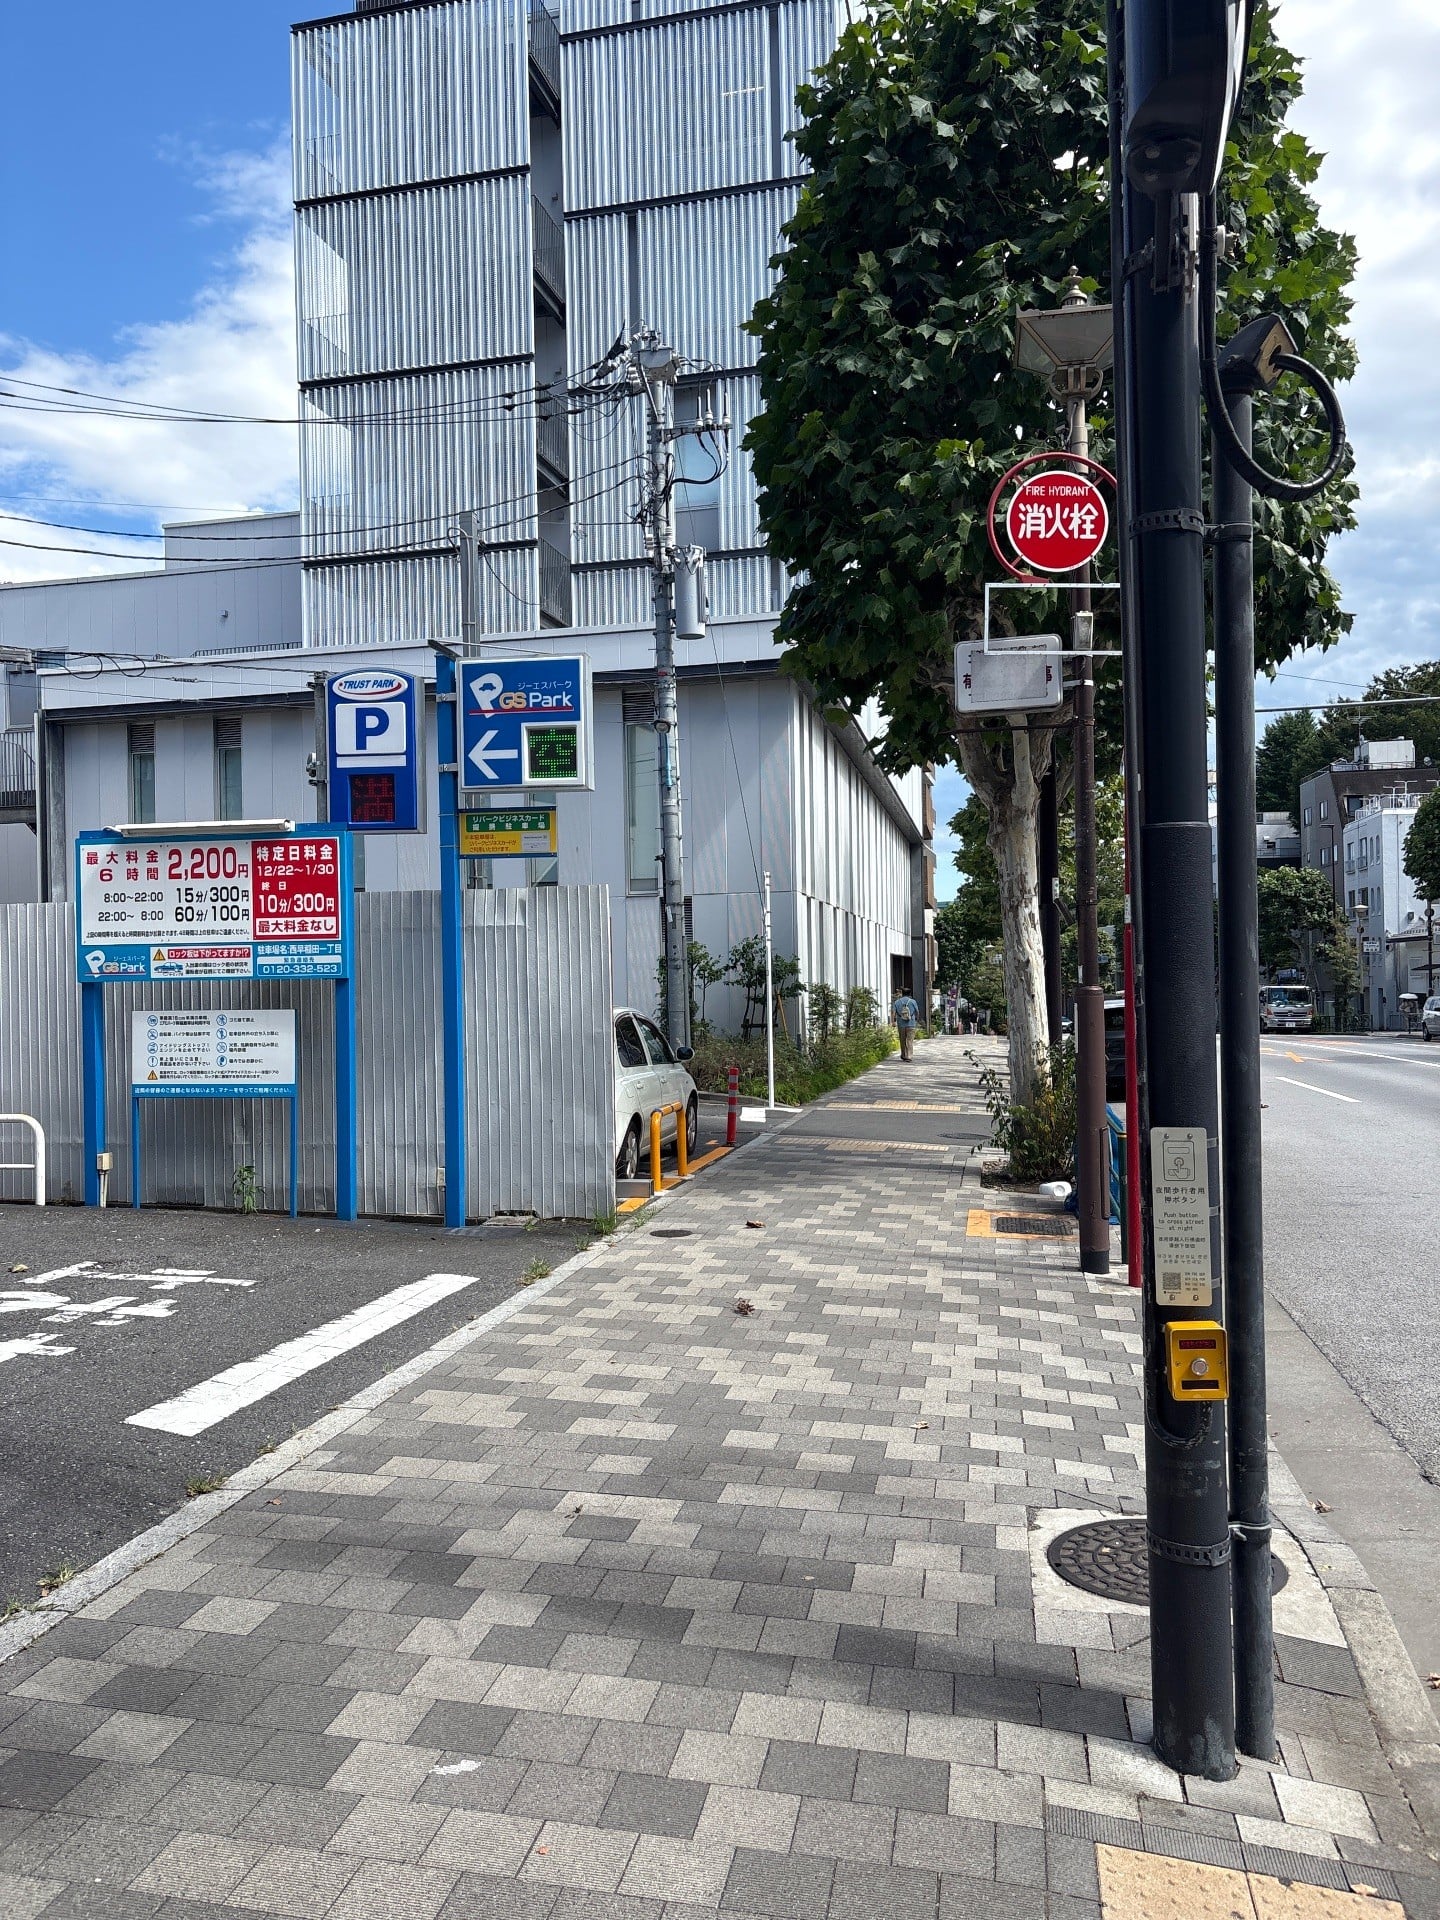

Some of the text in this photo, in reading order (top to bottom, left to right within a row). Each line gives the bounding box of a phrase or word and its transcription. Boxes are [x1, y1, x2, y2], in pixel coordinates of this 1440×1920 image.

[1025, 485, 1090, 497] FIRE HYDRANT
[1017, 502, 1099, 540] 消火栓
[342, 678, 396, 690] TRUST PARK
[355, 707, 390, 751] P
[529, 728, 577, 779] 空
[85, 849, 160, 865] 最大料金
[257, 845, 333, 862] 特定日料金
[168, 846, 249, 882] 2,200円
[261, 881, 287, 891] 終日
[176, 886, 250, 904] 15分/300円
[258, 893, 335, 914] 10分/300円
[175, 904, 250, 923] 60分/100円
[258, 919, 335, 934] 最大料金なし
[262, 964, 338, 974] 0120-332-523
[1155, 1186, 1206, 1195] 夜間歩行者用
[1164, 1196, 1197, 1204] 押ボタン
